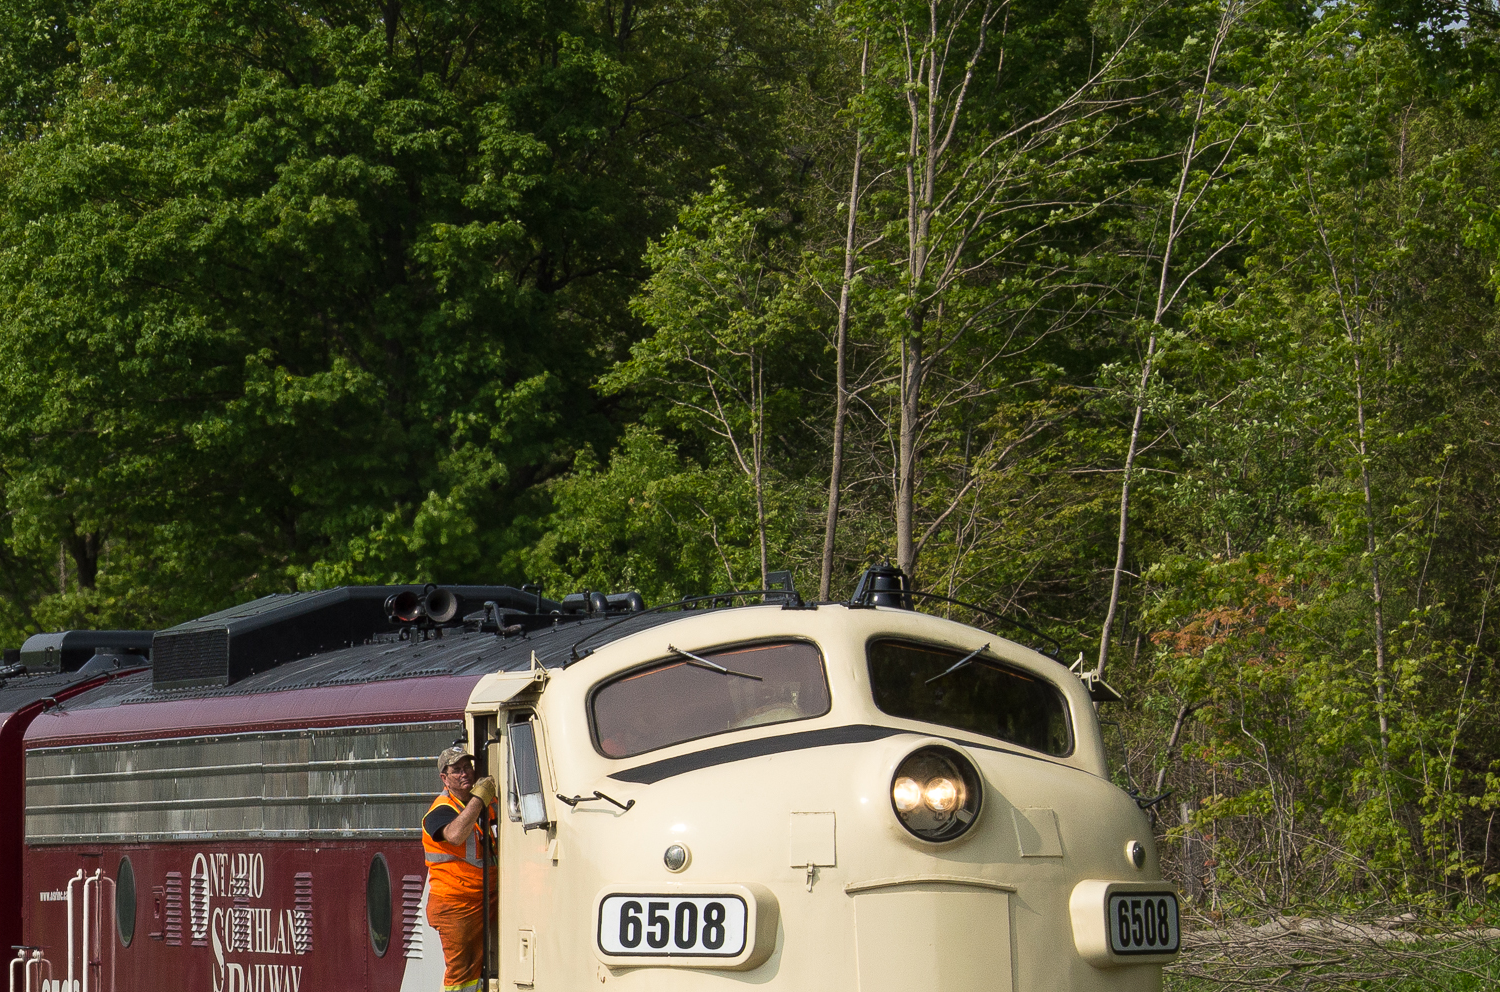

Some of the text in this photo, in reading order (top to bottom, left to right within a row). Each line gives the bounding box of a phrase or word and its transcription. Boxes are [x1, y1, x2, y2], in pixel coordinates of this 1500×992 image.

[189, 852, 265, 940] ONTARIO
[619, 900, 726, 950] 6508
[1117, 899, 1170, 948] 6508
